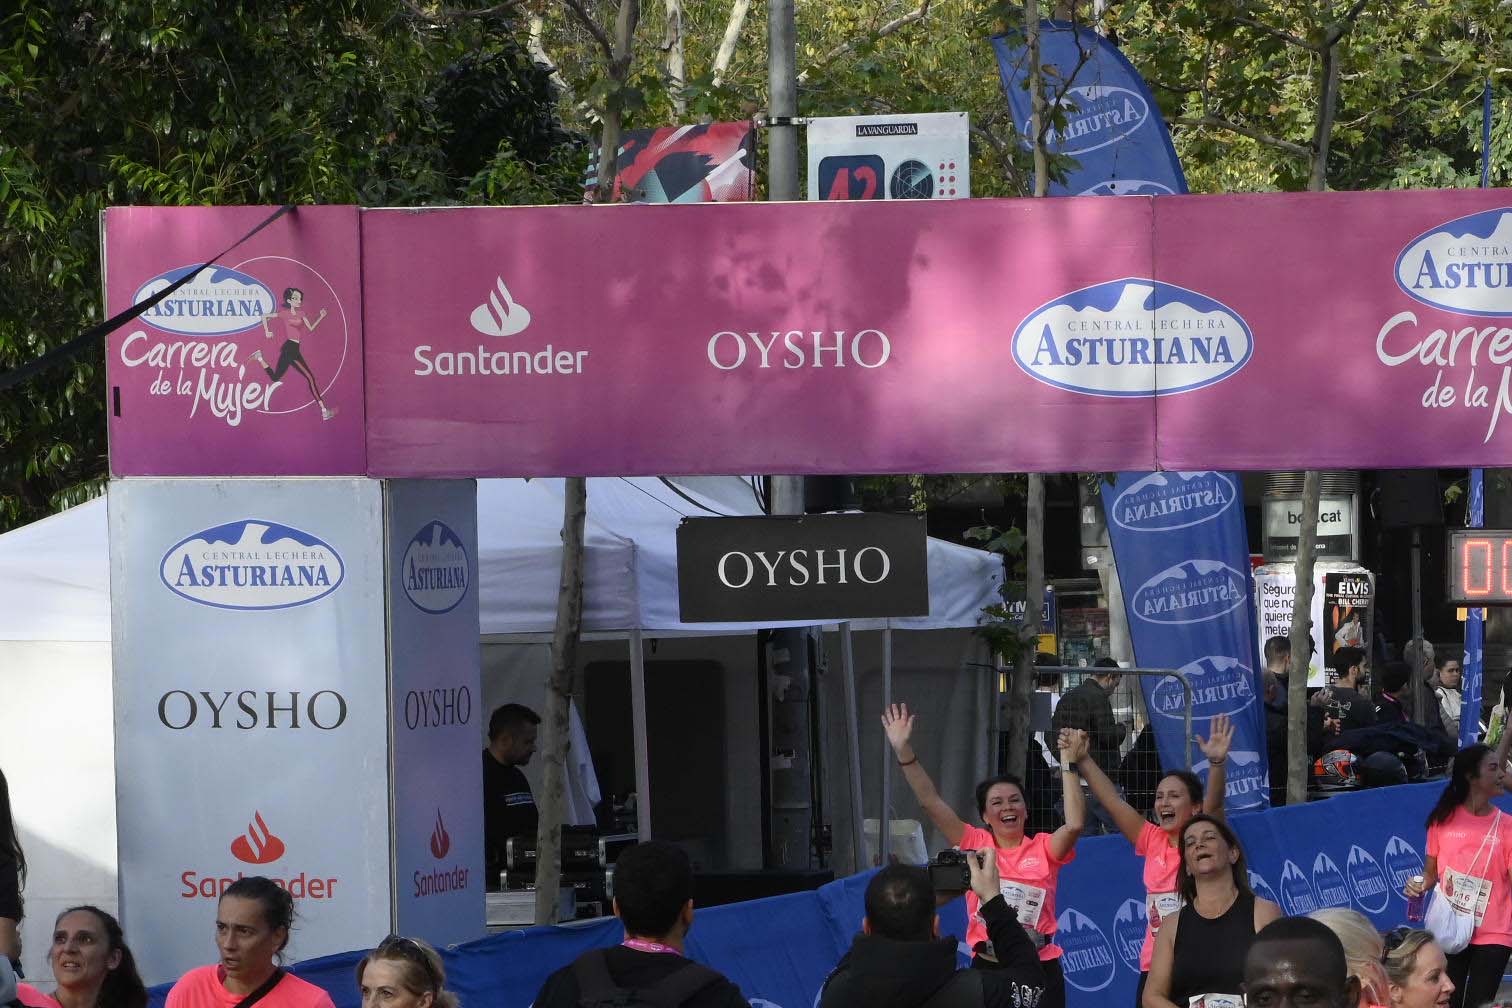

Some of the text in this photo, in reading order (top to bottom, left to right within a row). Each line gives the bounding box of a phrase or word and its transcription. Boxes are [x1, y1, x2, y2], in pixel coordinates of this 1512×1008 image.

[858, 124, 916, 135] LA VANGUARDIA
[144, 289, 264, 318] ASTURIANA
[215, 288, 260, 296] LECHERA
[1068, 318, 1226, 331] CENTRAL LECHERA
[120, 331, 238, 369] Carrera
[414, 345, 588, 377] Santander
[707, 329, 891, 371] OYSHO
[1031, 323, 1234, 367] ASTURIANA
[150, 370, 192, 396] de la
[189, 364, 283, 427] Mujer
[1421, 366, 1489, 408] de la
[174, 553, 331, 587] ASTURIANA
[202, 550, 326, 561] CENTRAL LECHERA
[718, 546, 890, 589] OYSHO
[407, 555, 466, 591] ASTURIANA
[1339, 582, 1369, 595] ELVIS
[1264, 599, 1280, 611] que
[157, 689, 348, 730] OYSHO
[405, 685, 472, 730] OYSHO
[181, 871, 337, 899] Sander
[414, 866, 469, 899] Santander
